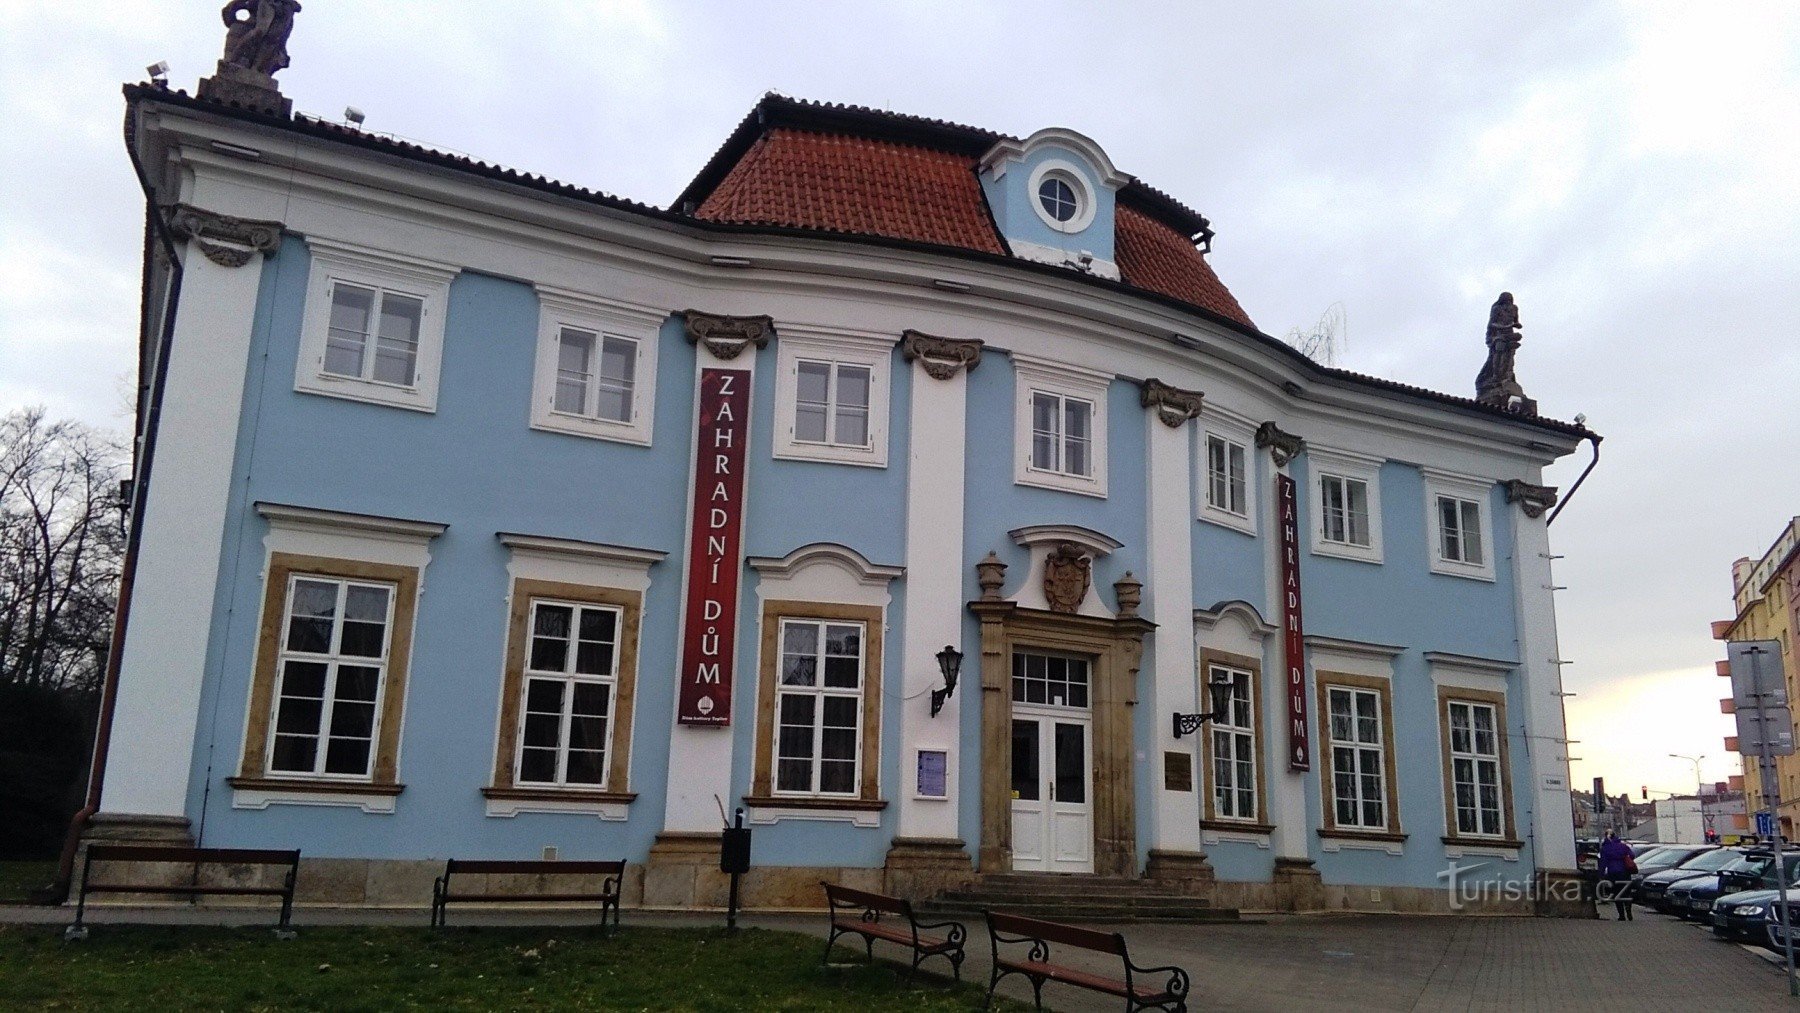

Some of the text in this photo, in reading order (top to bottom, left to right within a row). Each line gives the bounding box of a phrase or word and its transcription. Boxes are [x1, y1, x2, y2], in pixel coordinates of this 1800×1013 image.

[695, 376, 734, 684] ZAHRADNÍ DŮM
[1285, 482, 1304, 737] ZAHRADNÍ DŮM
